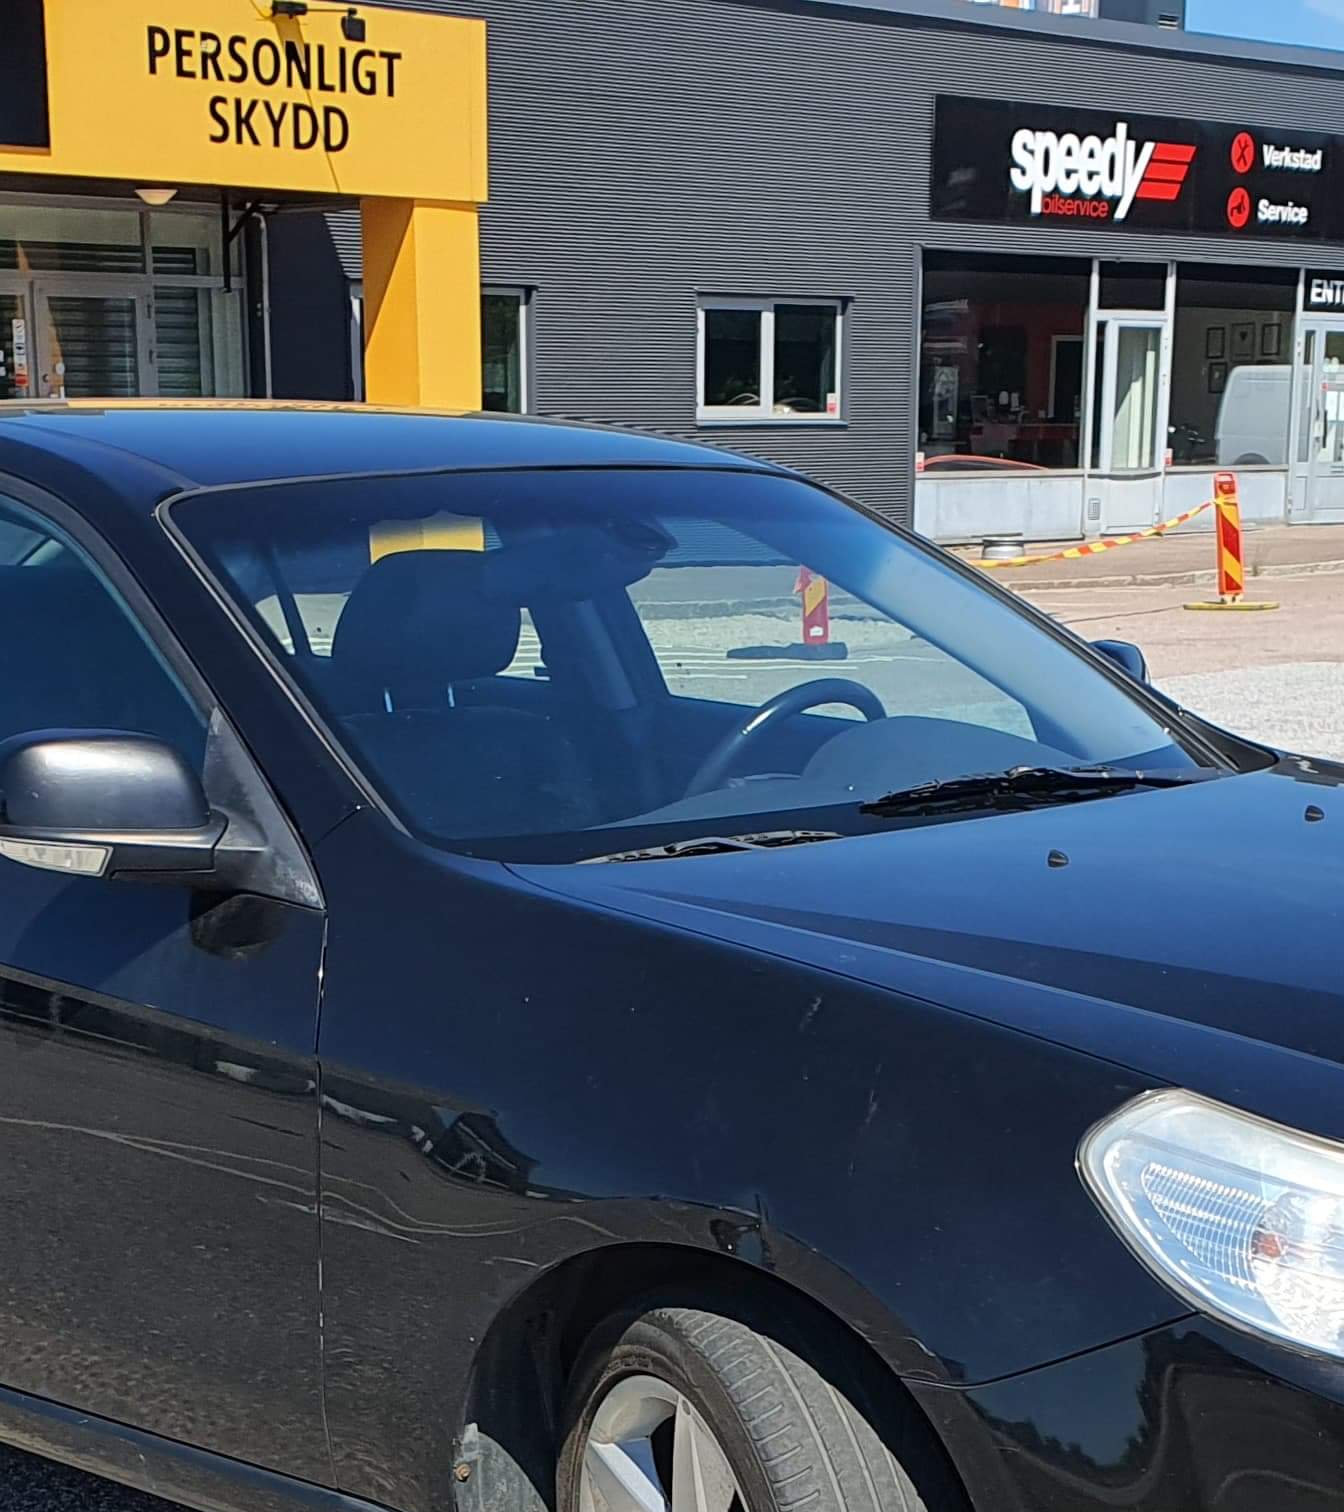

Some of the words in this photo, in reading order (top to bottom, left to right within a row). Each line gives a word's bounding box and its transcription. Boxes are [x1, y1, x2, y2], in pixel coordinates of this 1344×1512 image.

[146, 25, 403, 98] PERSONLIGT
[208, 95, 349, 153] SKYDD
[1010, 122, 1155, 220] speedy
[1262, 144, 1323, 171] Verkstad
[1041, 195, 1109, 218] bilservice
[1257, 198, 1309, 225] Service
